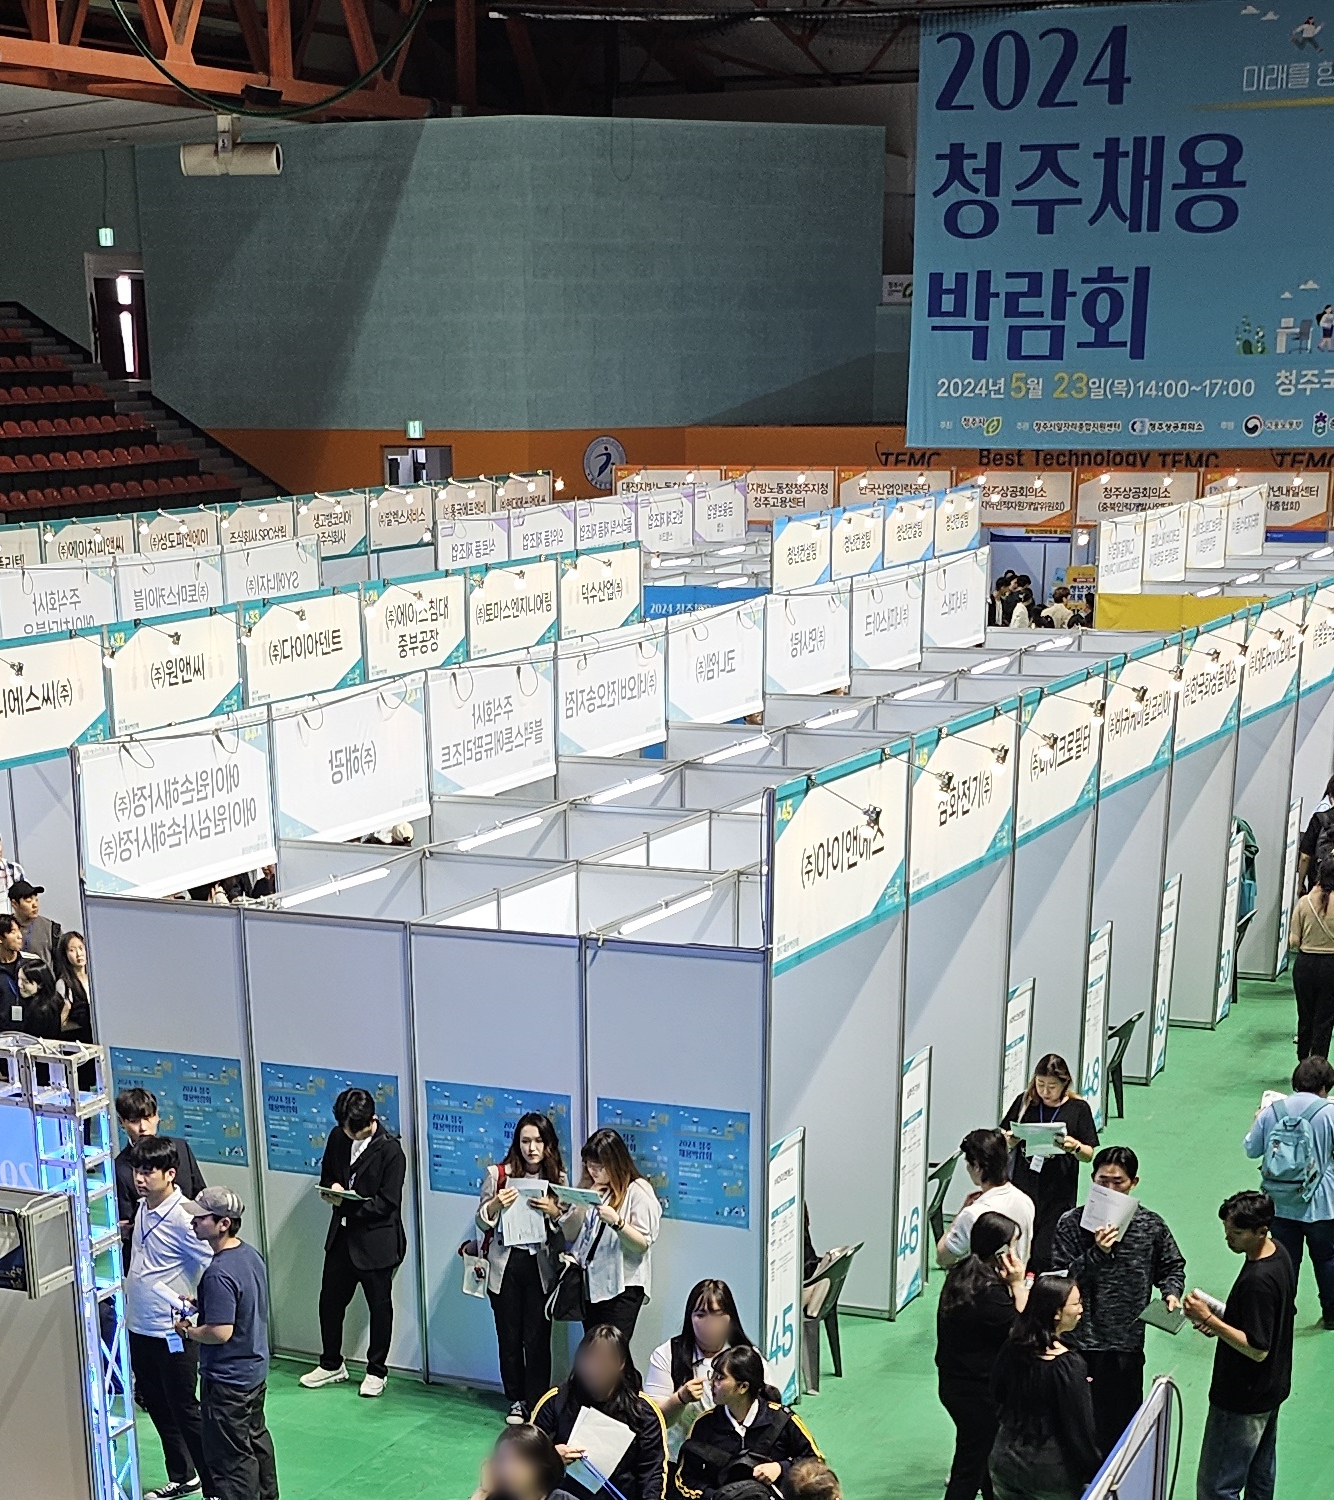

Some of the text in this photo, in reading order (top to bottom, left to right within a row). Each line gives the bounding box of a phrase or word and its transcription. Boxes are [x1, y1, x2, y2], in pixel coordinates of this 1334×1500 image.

[934, 24, 1132, 111] 2024
[1242, 63, 1310, 92] 미래를
[931, 133, 1248, 239] 청주채용
[927, 266, 1151, 361] 박람회
[937, 377, 1005, 399] 2024년
[1010, 372, 1044, 398] 5월
[978, 448, 1023, 467] Best
[1031, 449, 1149, 468] Technology
[1102, 486, 1172, 499] 청주상공회의소
[581, 577, 623, 604] 덕수산업(주)
[650, 603, 673, 614] 2024
[268, 628, 343, 665] (주)다이아덴트
[397, 629, 440, 659] 중부공장
[150, 654, 205, 689] (주)원앤씨
